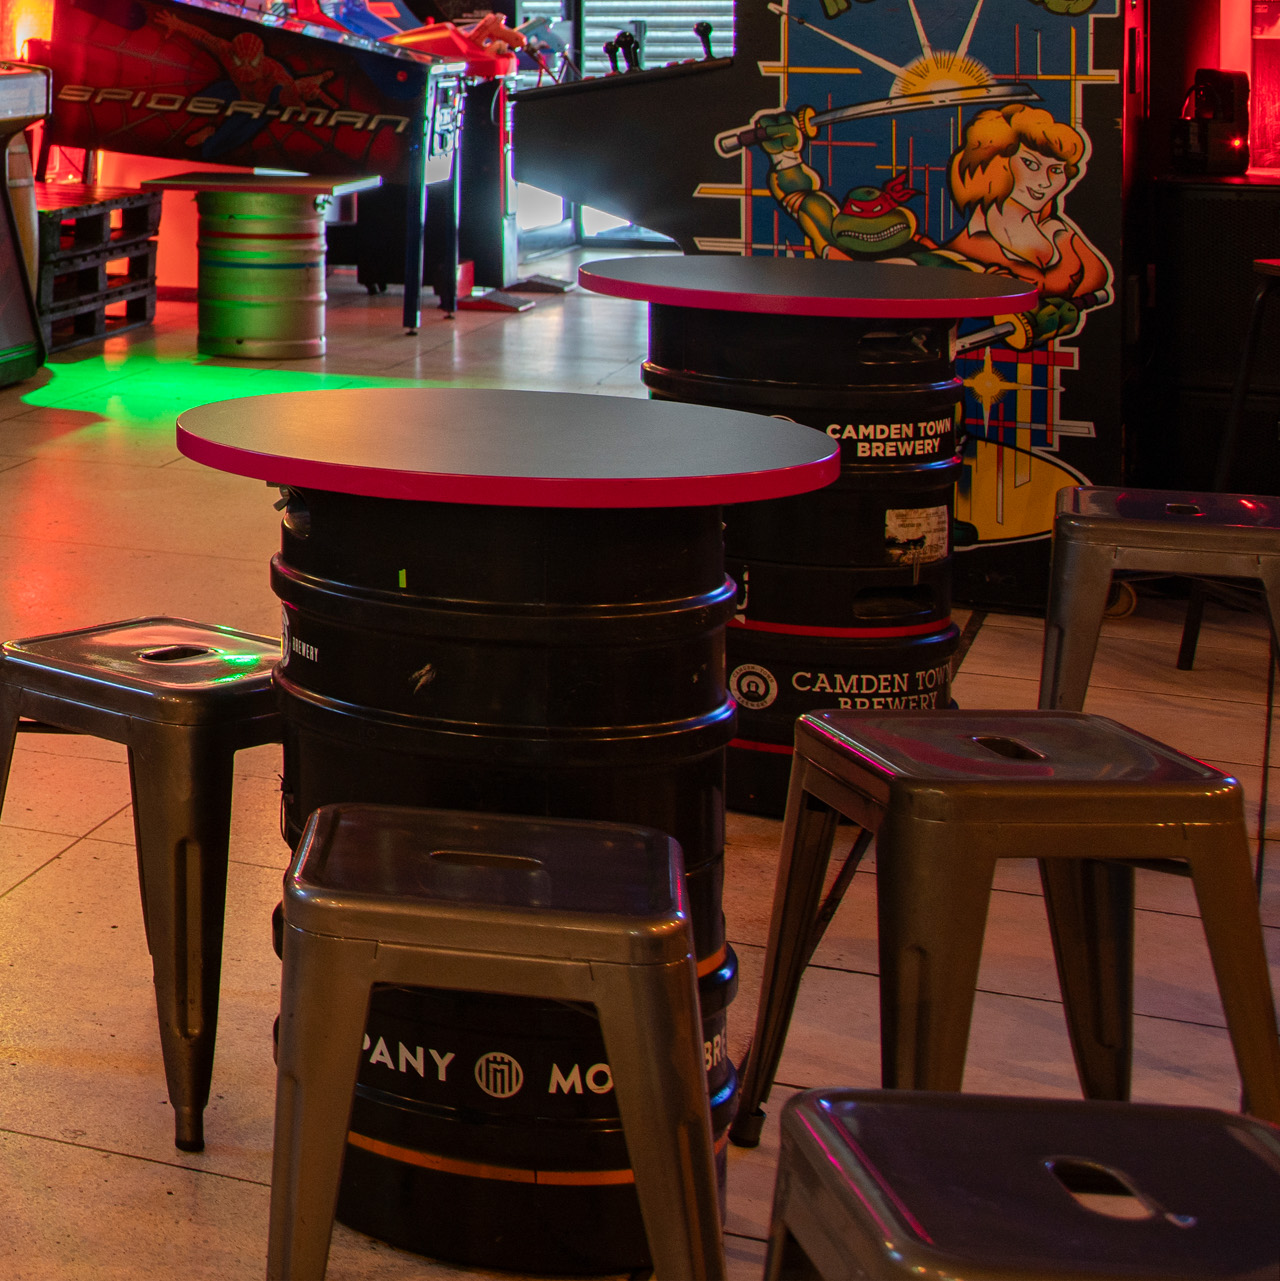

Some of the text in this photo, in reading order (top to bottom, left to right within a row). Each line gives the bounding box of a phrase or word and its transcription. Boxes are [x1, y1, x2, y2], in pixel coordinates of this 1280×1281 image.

[57, 83, 411, 134] SPIDER-MAN
[826, 417, 952, 440] CAMDEN TOWN
[856, 437, 941, 458] BREWERY
[292, 636, 319, 663] BREWERY
[791, 671, 909, 694] CAMDEN
[838, 691, 938, 710] BREWERY
